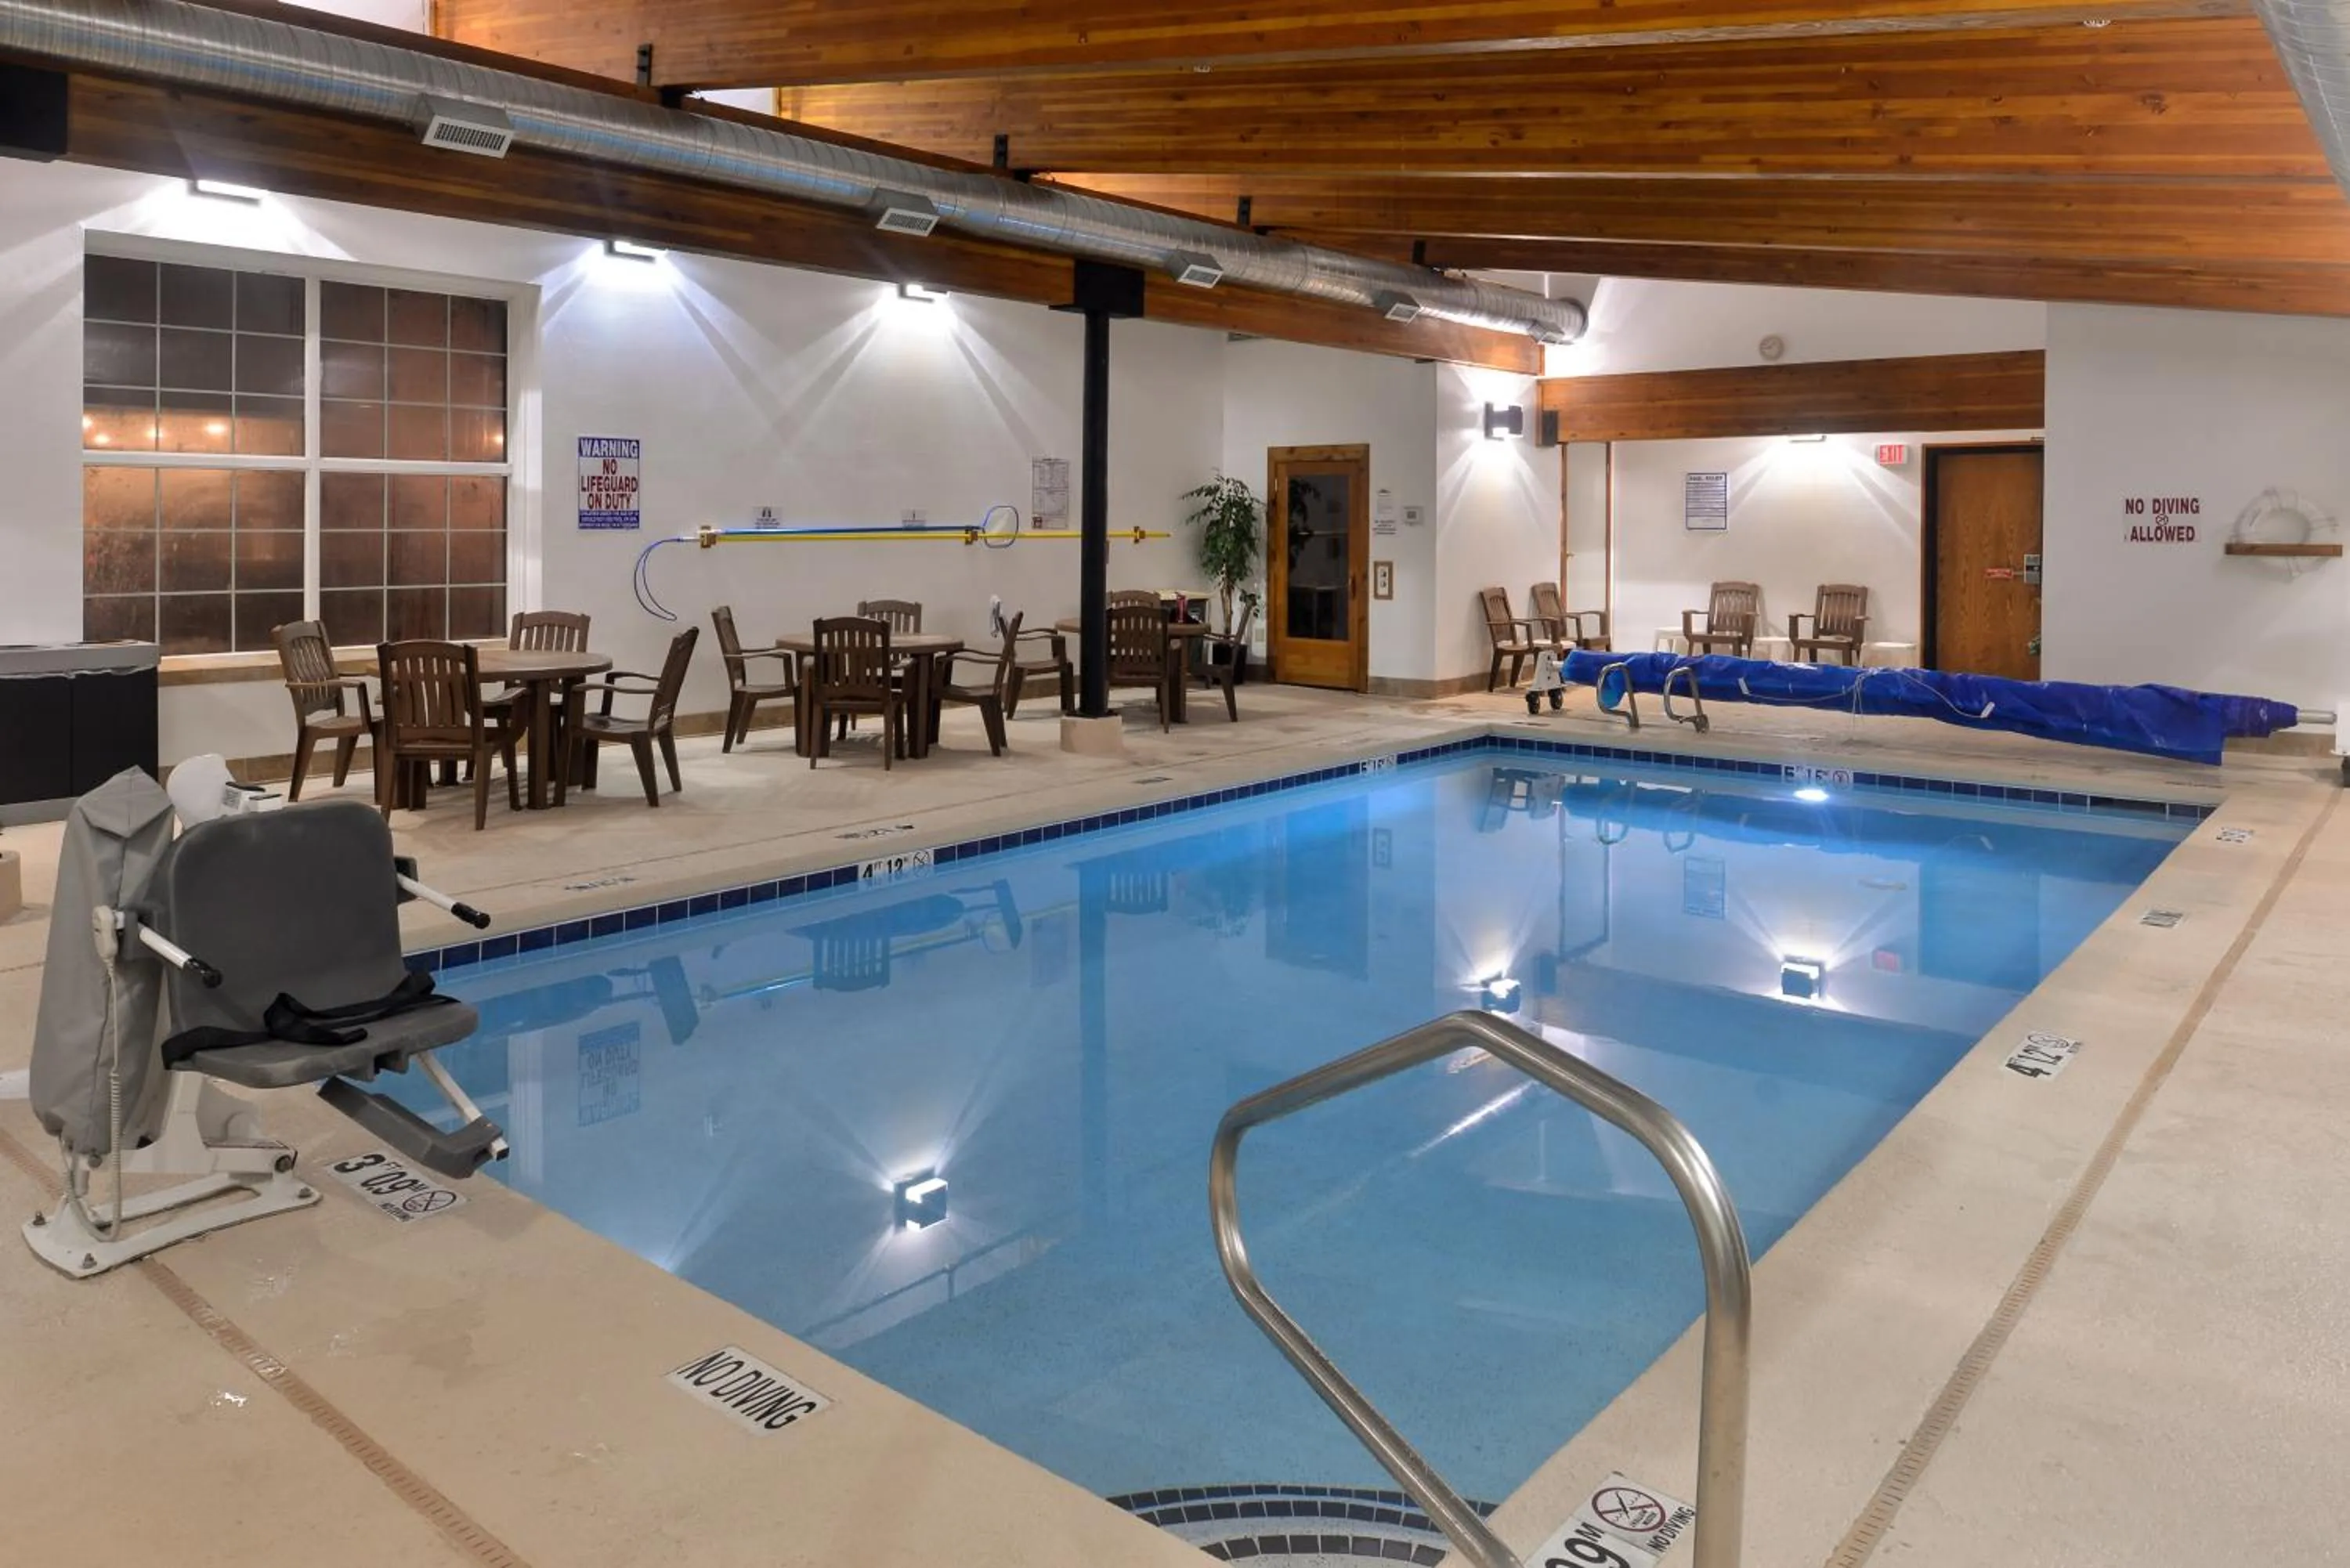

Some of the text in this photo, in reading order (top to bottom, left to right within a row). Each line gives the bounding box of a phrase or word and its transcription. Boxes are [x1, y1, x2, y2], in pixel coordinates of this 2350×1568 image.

[580, 439, 638, 457] WARNING
[1880, 445, 1904, 464] EXIT
[602, 459, 617, 475] NO
[580, 476, 638, 492] LIFEGUARD
[588, 493, 632, 509] ON DUTY
[2125, 498, 2200, 514] NO DIVING
[2130, 526, 2195, 542] ALLOWED
[677, 1351, 817, 1429] NO DIVING
[1658, 1506, 1696, 1540] DIVING
[1647, 1533, 1670, 1552] NO
